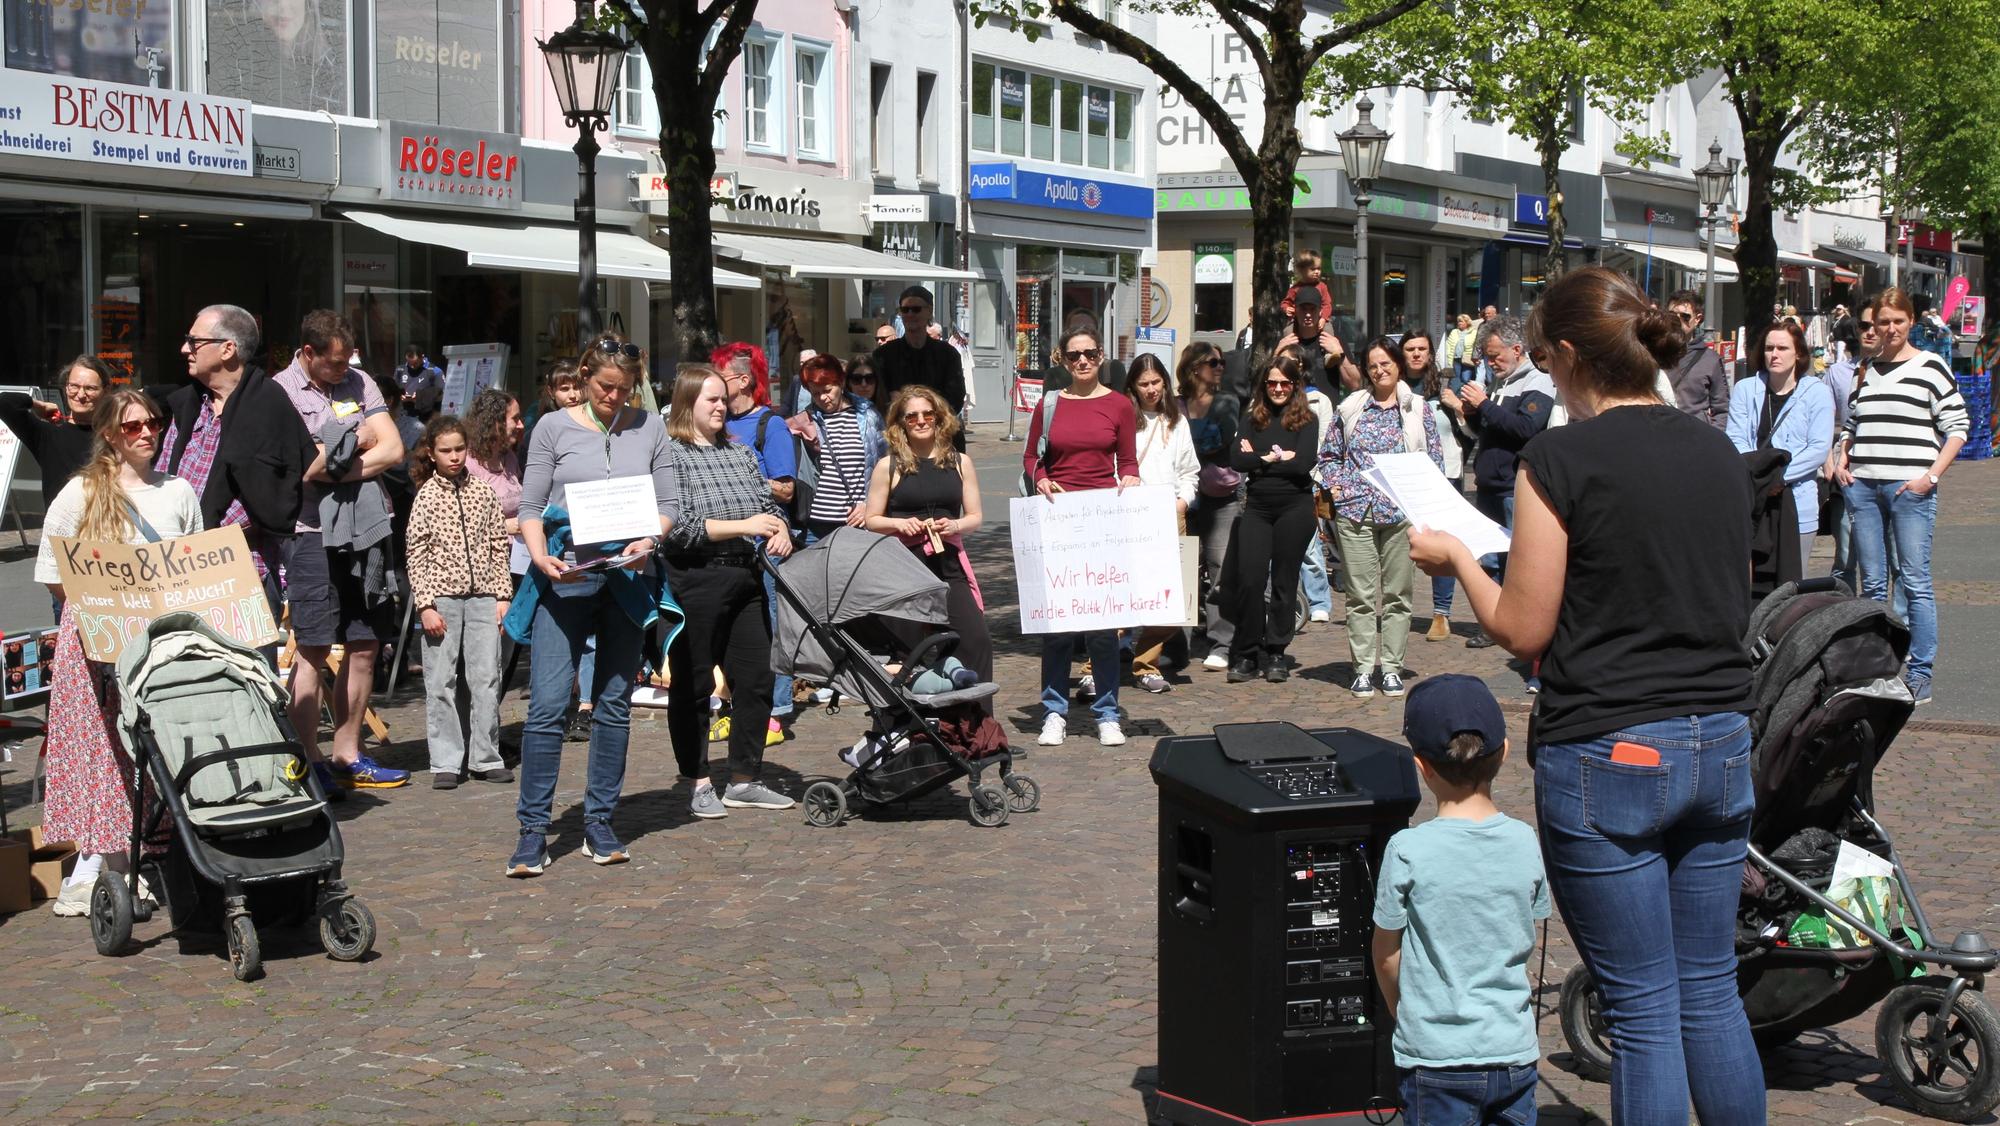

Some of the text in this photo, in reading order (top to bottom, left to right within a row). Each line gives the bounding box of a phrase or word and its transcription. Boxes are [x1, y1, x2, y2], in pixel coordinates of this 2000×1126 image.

[395, 36, 482, 71] Röseler
[51, 84, 245, 146] BESTMANN
[92, 140, 149, 162] Stempel
[156, 148, 181, 164] und
[188, 150, 248, 171] Gravuren
[256, 153, 295, 169] Markt 3
[400, 135, 518, 182] Röseler
[398, 176, 513, 200] Schuhkonzept
[971, 173, 1010, 189] Apollo
[1044, 177, 1079, 204] Apollo
[62, 540, 236, 586] Krieg & Krisen
[1046, 562, 1130, 590] Wir helfen
[122, 591, 152, 609] Welt
[164, 579, 236, 608] BRAUCHT
[137, 584, 165, 593] noch
[172, 579, 190, 590] nie
[1029, 605, 1044, 620] und
[1046, 600, 1067, 618] die
